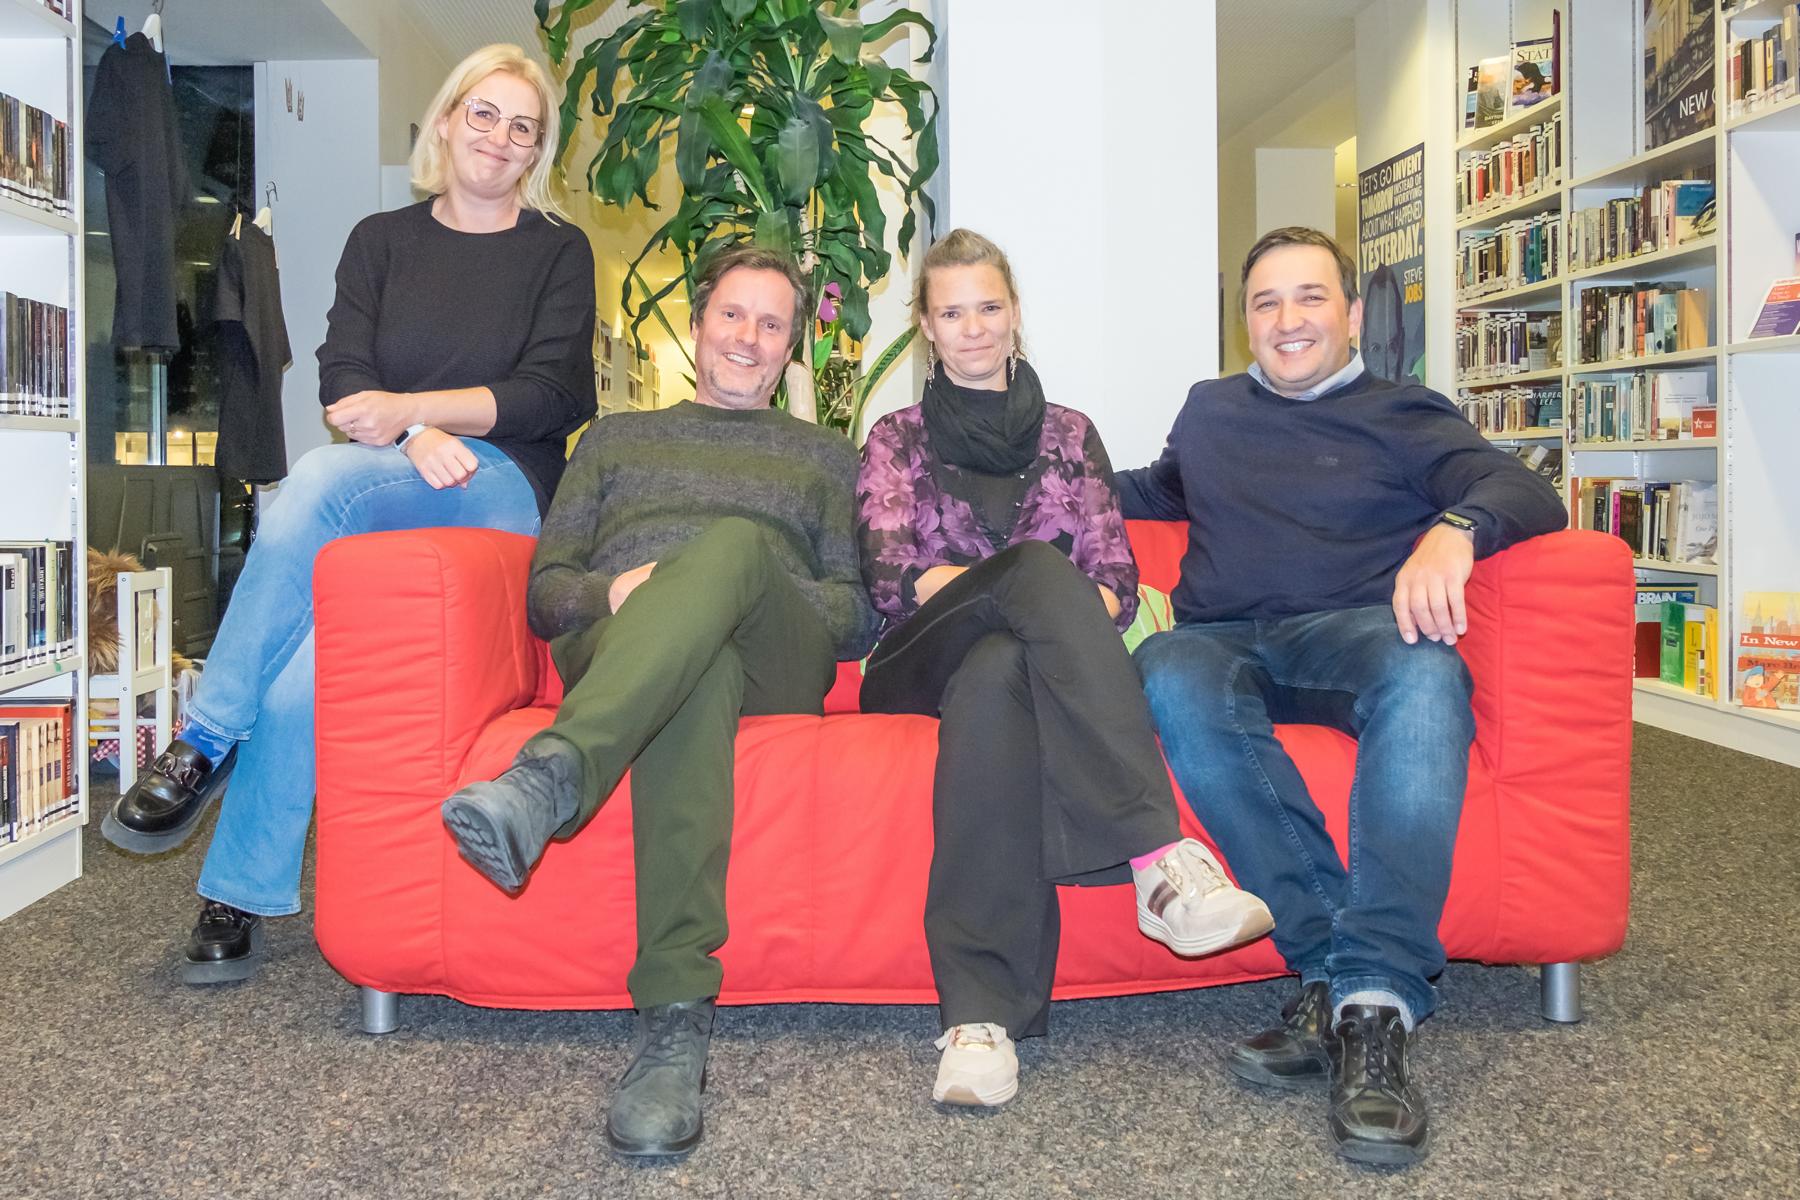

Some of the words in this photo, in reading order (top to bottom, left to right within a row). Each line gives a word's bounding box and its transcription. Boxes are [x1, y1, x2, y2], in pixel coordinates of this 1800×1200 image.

[1680, 89, 1708, 119] NEW
[1361, 173, 1378, 196] LET'S
[1380, 166, 1392, 187] GO
[1393, 150, 1422, 182] INVENT
[1415, 172, 1422, 186] OF
[1361, 217, 1380, 241] ABOUT
[1380, 211, 1393, 234] WHAT
[1394, 200, 1423, 228] HAPPENED
[1404, 267, 1423, 285] STEVE
[1404, 284, 1423, 304] JOBS
[1531, 391, 1562, 399] HARPER
[1540, 398, 1553, 406] LEE
[1637, 592, 1677, 604] BRAIN
[1742, 635, 1759, 645] In
[1764, 636, 1798, 647] New
